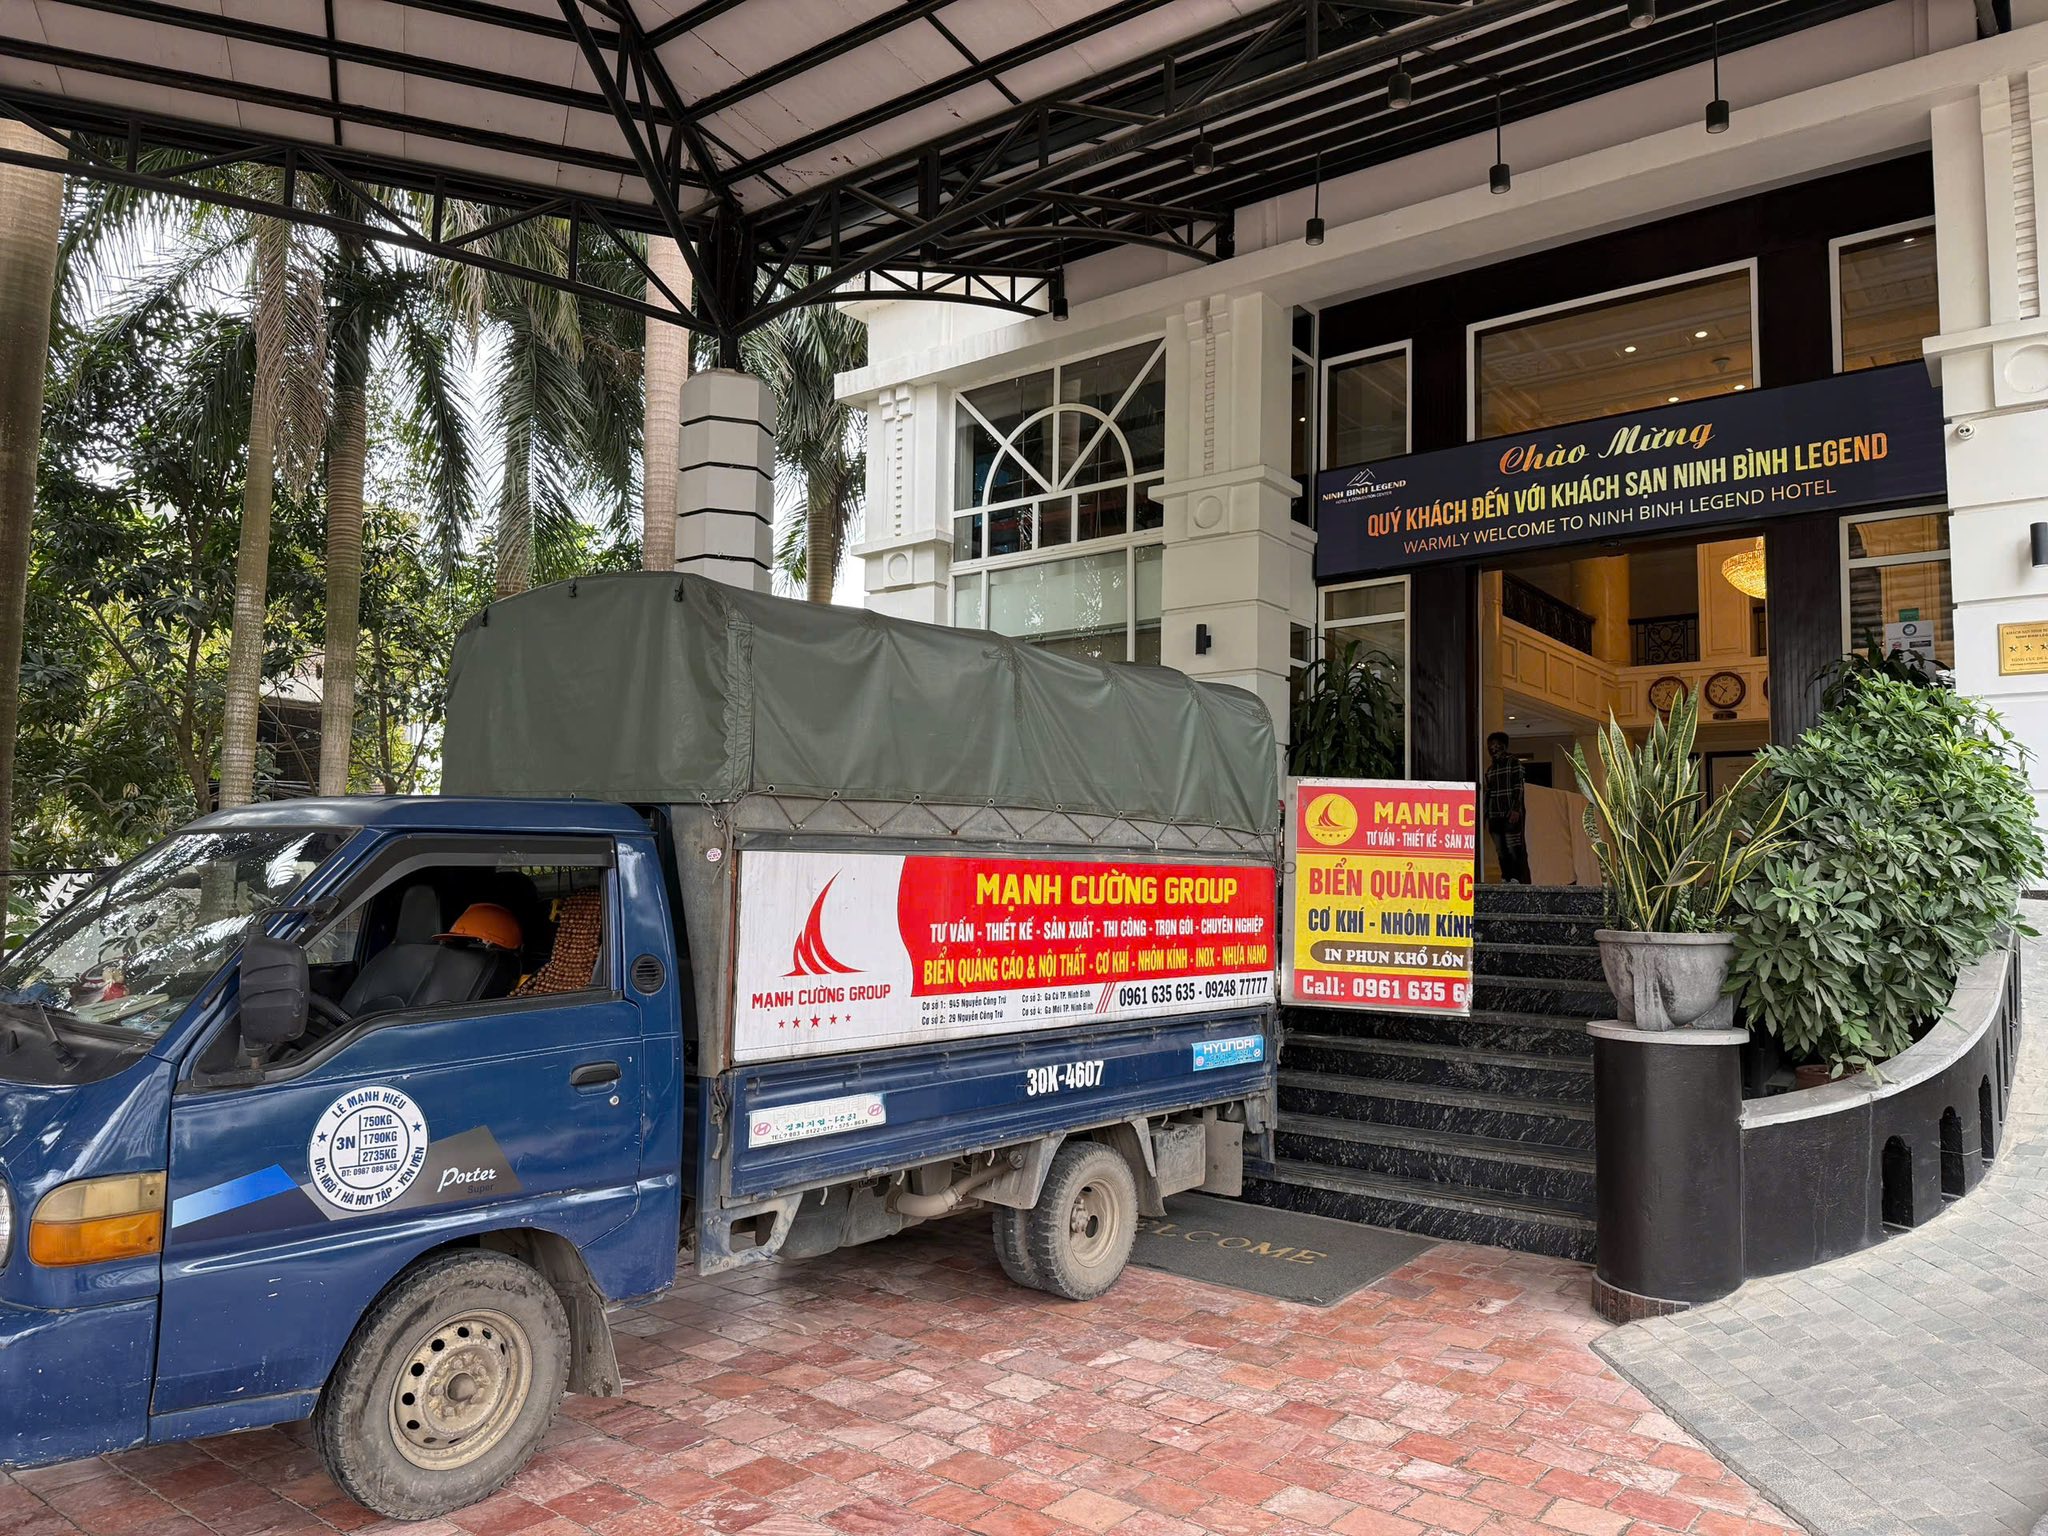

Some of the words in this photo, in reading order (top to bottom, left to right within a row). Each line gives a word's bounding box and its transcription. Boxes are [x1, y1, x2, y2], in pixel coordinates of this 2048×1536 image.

[1500, 443, 1589, 475] Chào
[1598, 423, 1715, 459] Mừng
[1322, 491, 1344, 500] NINH
[1370, 480, 1406, 492] LEGEND
[1368, 506, 1402, 537] QUÝ
[1406, 499, 1466, 531] KHÁCH
[1472, 487, 1509, 521] ĐẾN
[1514, 483, 1545, 514] VỚI
[1551, 473, 1620, 508] KHÁCH
[1625, 466, 1667, 499] SẠN
[1673, 458, 1726, 489] NINH
[1733, 446, 1787, 480] BÌNH
[1795, 432, 1888, 472] LEGEND
[1404, 532, 1469, 554] WARMLY
[1474, 520, 1555, 542] WELCOME
[1560, 515, 1583, 531] TO
[1588, 508, 1633, 528] NINH
[1639, 501, 1683, 520] BINH
[1690, 489, 1764, 513] LEGEND
[1771, 480, 1837, 502] HOTEL
[1374, 800, 1449, 830] MẠNH
[1458, 804, 1475, 827] C
[1366, 830, 1378, 845] TƯ
[1378, 826, 1394, 846] VẤN
[1402, 828, 1425, 847] THIẾT
[1426, 828, 1438, 848] KẾ
[1444, 829, 1462, 849] SẢN
[976, 873, 1061, 912] MẠNH
[1071, 869, 1157, 904] CƯỜNG
[1165, 877, 1237, 904] GROUP
[1309, 857, 1362, 896] BIỂN
[1370, 862, 1450, 900] QUẢNG
[1458, 873, 1473, 901] C
[930, 920, 947, 943] TƯ
[950, 916, 974, 942] VẤN
[986, 916, 1016, 942] THIẾT
[1019, 916, 1034, 940] KẾ
[1044, 916, 1066, 939] SẢN
[1068, 915, 1094, 939] XUẤT
[1103, 920, 1118, 938] THI
[1120, 917, 1146, 937] CÔNG
[1155, 919, 1176, 939] TRỌN
[1179, 916, 1193, 935] GÓI
[1201, 915, 1233, 934] CHUYÊN
[1235, 914, 1264, 936] NGHIỆP
[1308, 906, 1331, 932] CƠ
[1335, 906, 1364, 933] KHÍ
[1380, 908, 1430, 936] NHÔM
[924, 946, 955, 985] BIỂN
[958, 948, 998, 988] QUẢNG
[1002, 950, 1024, 980] CÁO
[1027, 958, 1035, 978] &
[1039, 948, 1056, 983] NỘI
[1060, 944, 1086, 977] THẤT
[1096, 949, 1110, 974] CƠ
[1112, 945, 1130, 973] KHÍ
[1138, 944, 1164, 971] NHÔM
[1167, 943, 1187, 969] KÍNH
[1196, 947, 1214, 967] INOX
[1222, 942, 1245, 970] NHỰA
[1247, 944, 1266, 964] NANO
[1324, 947, 1343, 961] IN
[1346, 950, 1390, 964] PHUN
[1394, 946, 1428, 967] KHỔ
[1432, 950, 1464, 968] LỚN
[752, 990, 794, 1011] MẠNH
[798, 985, 844, 1005] CƯỜNG
[850, 984, 890, 1000] GROUP
[1119, 986, 1148, 1007] 0961
[1152, 984, 1172, 1004] 635
[1175, 982, 1195, 1001] 635
[1205, 979, 1236, 998] 09248
[1240, 977, 1268, 996] 77777
[1302, 975, 1345, 997] Call:
[1352, 978, 1400, 999] 0961
[1408, 980, 1445, 1001] 635
[949, 999, 960, 1008] 945
[1203, 1039, 1254, 1054] HYUNDAI
[1027, 1060, 1104, 1096] 30K-4607
[332, 1102, 347, 1118] LÊ
[347, 1091, 379, 1108] MẠNH
[382, 1092, 406, 1110] HIẾU
[363, 1114, 392, 1128] 750KG
[336, 1136, 356, 1151] 3N
[364, 1131, 397, 1145] 1790KG
[363, 1148, 397, 1162] 2735KG
[334, 1188, 342, 1198] 1
[355, 1194, 374, 1206] HUY
[376, 1187, 393, 1202] TẬP
[398, 1167, 416, 1187] YÊN
[410, 1147, 425, 1168] VIÊN
[353, 1167, 369, 1176] 0987
[371, 1165, 384, 1174] 088
[436, 1166, 496, 1193] Porter
[467, 1184, 494, 1194] Super
